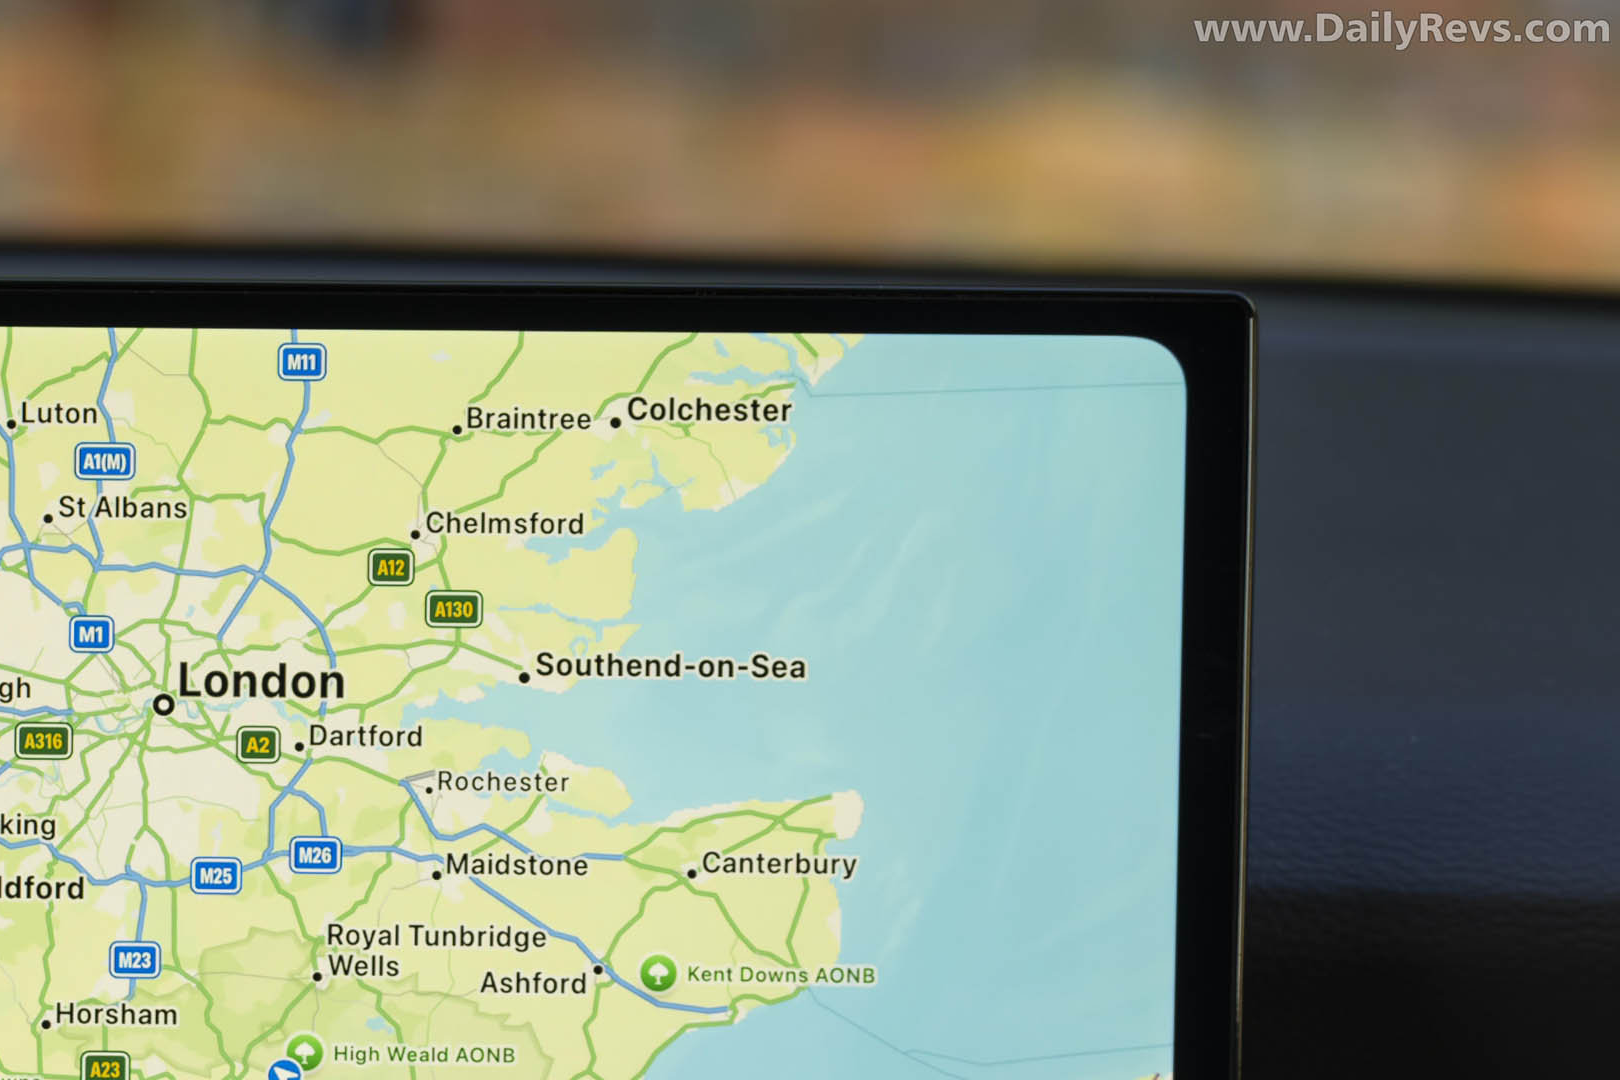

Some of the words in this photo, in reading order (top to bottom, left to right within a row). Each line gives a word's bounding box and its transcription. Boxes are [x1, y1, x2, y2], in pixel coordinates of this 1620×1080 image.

[287, 353, 316, 372] M11
[22, 401, 97, 424] Luton
[467, 406, 591, 430] Braintree
[627, 396, 792, 422] Colchester
[83, 452, 126, 474] A1(M)
[59, 495, 86, 518] St
[94, 496, 187, 519] Albans
[426, 511, 584, 535] Chelmsford
[378, 559, 404, 577] A12
[435, 601, 473, 619] A130
[79, 624, 103, 643] M1
[536, 652, 805, 679] Southend-on-Sea
[179, 661, 344, 699] London
[24, 732, 62, 750] A316
[246, 736, 270, 755] A2
[310, 724, 422, 747] Dartford
[438, 770, 569, 792] Rochester
[300, 847, 331, 864] M26
[447, 852, 588, 876] Maidstone
[702, 851, 857, 880] Canterbury
[201, 868, 232, 885] M25
[327, 923, 399, 951] Royal
[408, 924, 546, 953] Tunbridge
[119, 950, 151, 969] M23
[328, 954, 399, 977] Wells
[480, 971, 586, 994] Ashford
[688, 967, 732, 982] Kent
[740, 966, 808, 983] Downs
[815, 967, 875, 984] AONB
[56, 1002, 177, 1025] Horsham
[334, 1046, 380, 1065] High
[387, 1046, 448, 1063] Weald
[456, 1047, 515, 1063] AONB
[91, 1061, 120, 1079] A23
